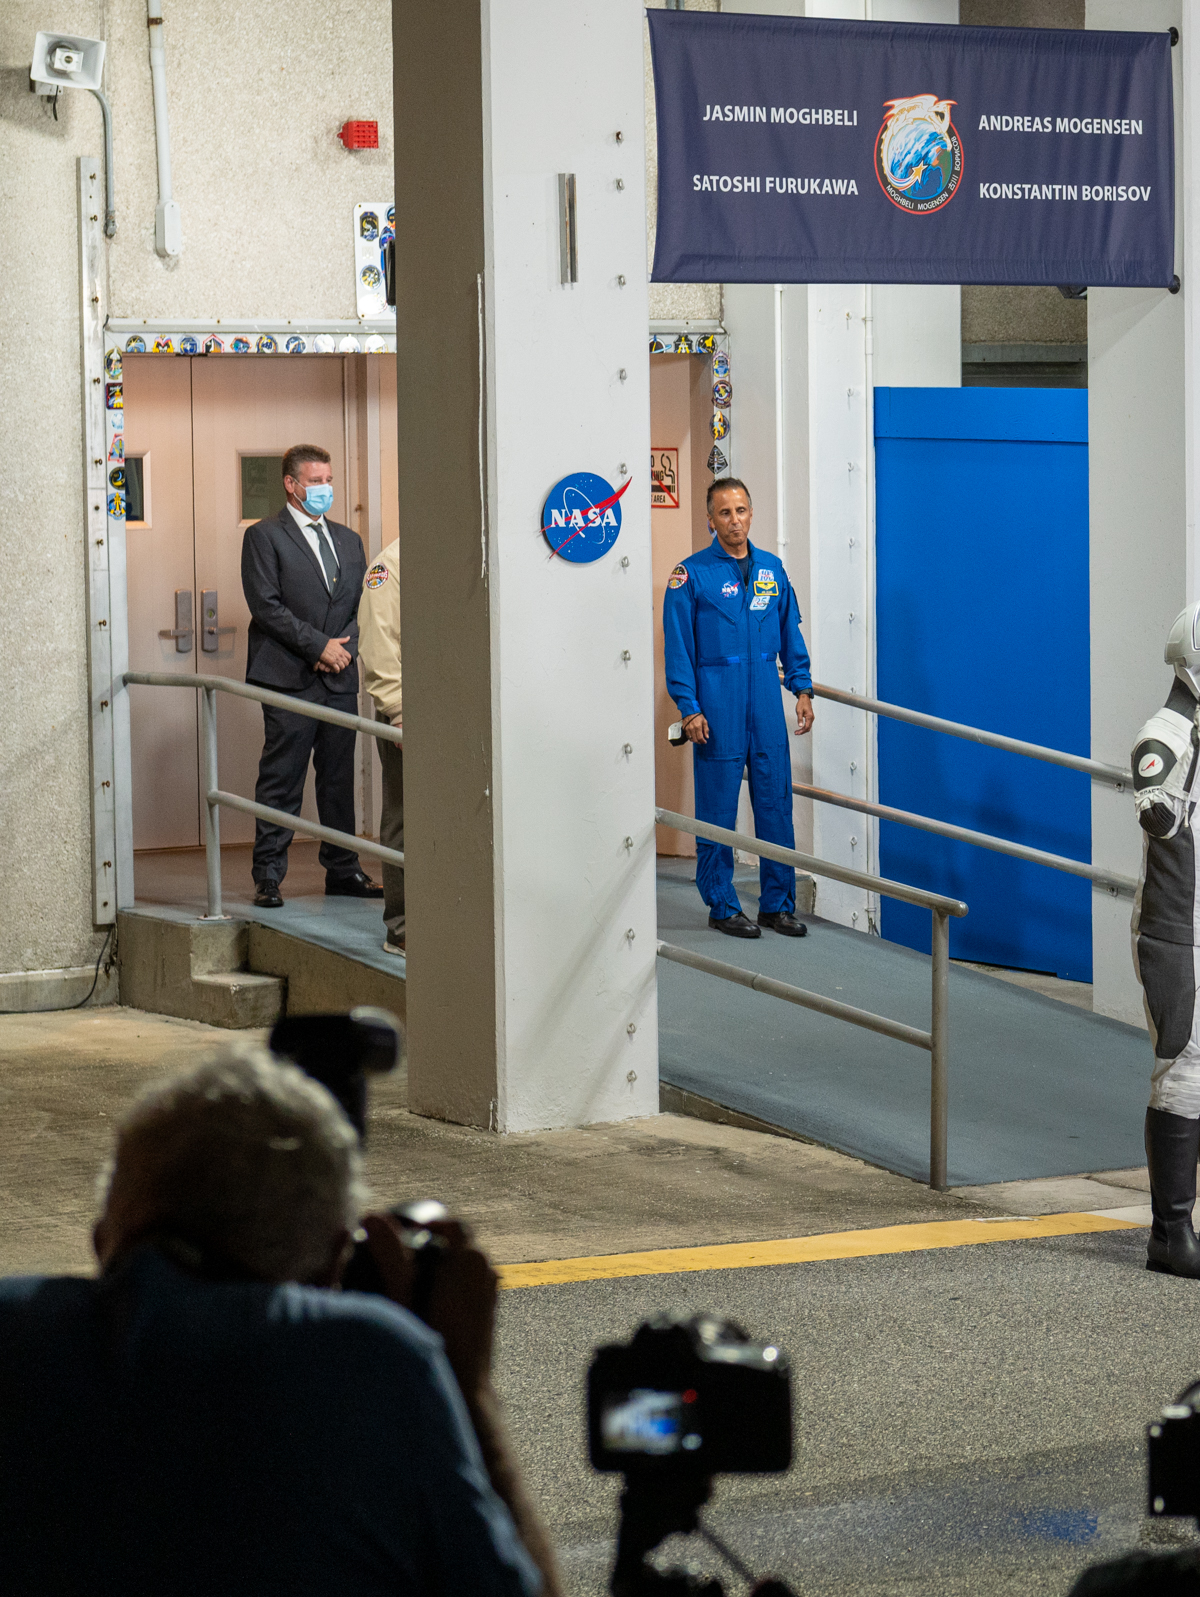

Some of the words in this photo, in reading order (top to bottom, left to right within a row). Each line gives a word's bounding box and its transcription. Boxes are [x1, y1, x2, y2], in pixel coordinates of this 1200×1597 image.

[703, 104, 766, 122] JASMIN
[770, 107, 858, 126] MOGHBELI
[978, 114, 1052, 132] ANDREAS
[1055, 117, 1143, 135] MOGENSEN
[692, 174, 761, 193] SATOSHI
[765, 177, 859, 196] FURUKAWA
[979, 182, 1078, 200] KONSTANTIN
[1081, 185, 1152, 202] BORISOV
[886, 184, 914, 209] MOGHBELI
[917, 192, 949, 211] MOGENSEN
[550, 508, 618, 528] NASA
